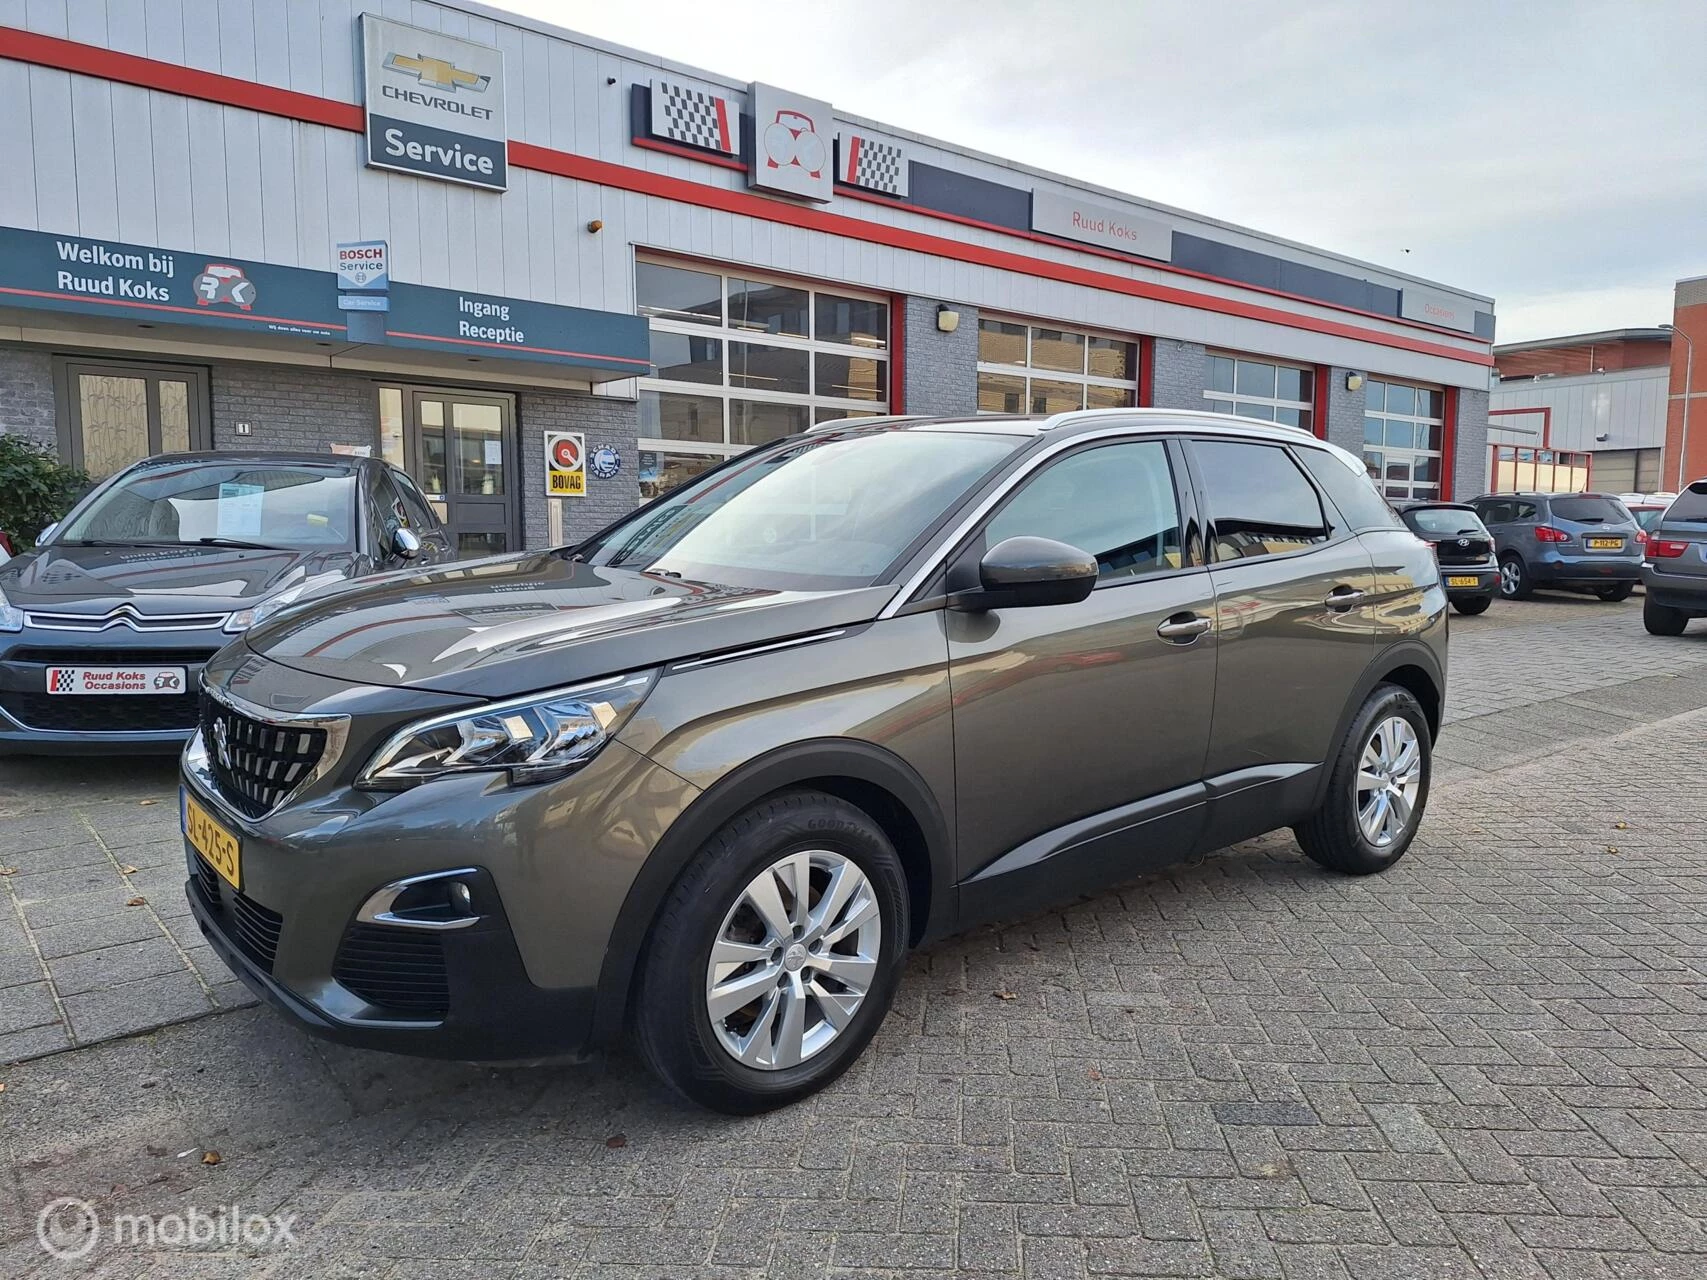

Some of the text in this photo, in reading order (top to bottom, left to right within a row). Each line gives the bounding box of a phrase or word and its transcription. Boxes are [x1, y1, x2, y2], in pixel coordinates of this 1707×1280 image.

[381, 85, 493, 120] CHEVROLET
[385, 128, 494, 175] Service
[1073, 211, 1137, 241] Ruud Koks
[56, 241, 175, 278] Welkom bij
[339, 249, 383, 260] BOSCH
[340, 260, 383, 270] Service
[57, 271, 170, 301] Ruud Koks
[459, 296, 510, 321] Ingang
[459, 320, 524, 343] Receptie
[552, 474, 581, 490] BOVAG
[82, 672, 146, 680] Ruud Koks
[84, 681, 146, 690] Occasions
[187, 801, 235, 877] SL-425-S
